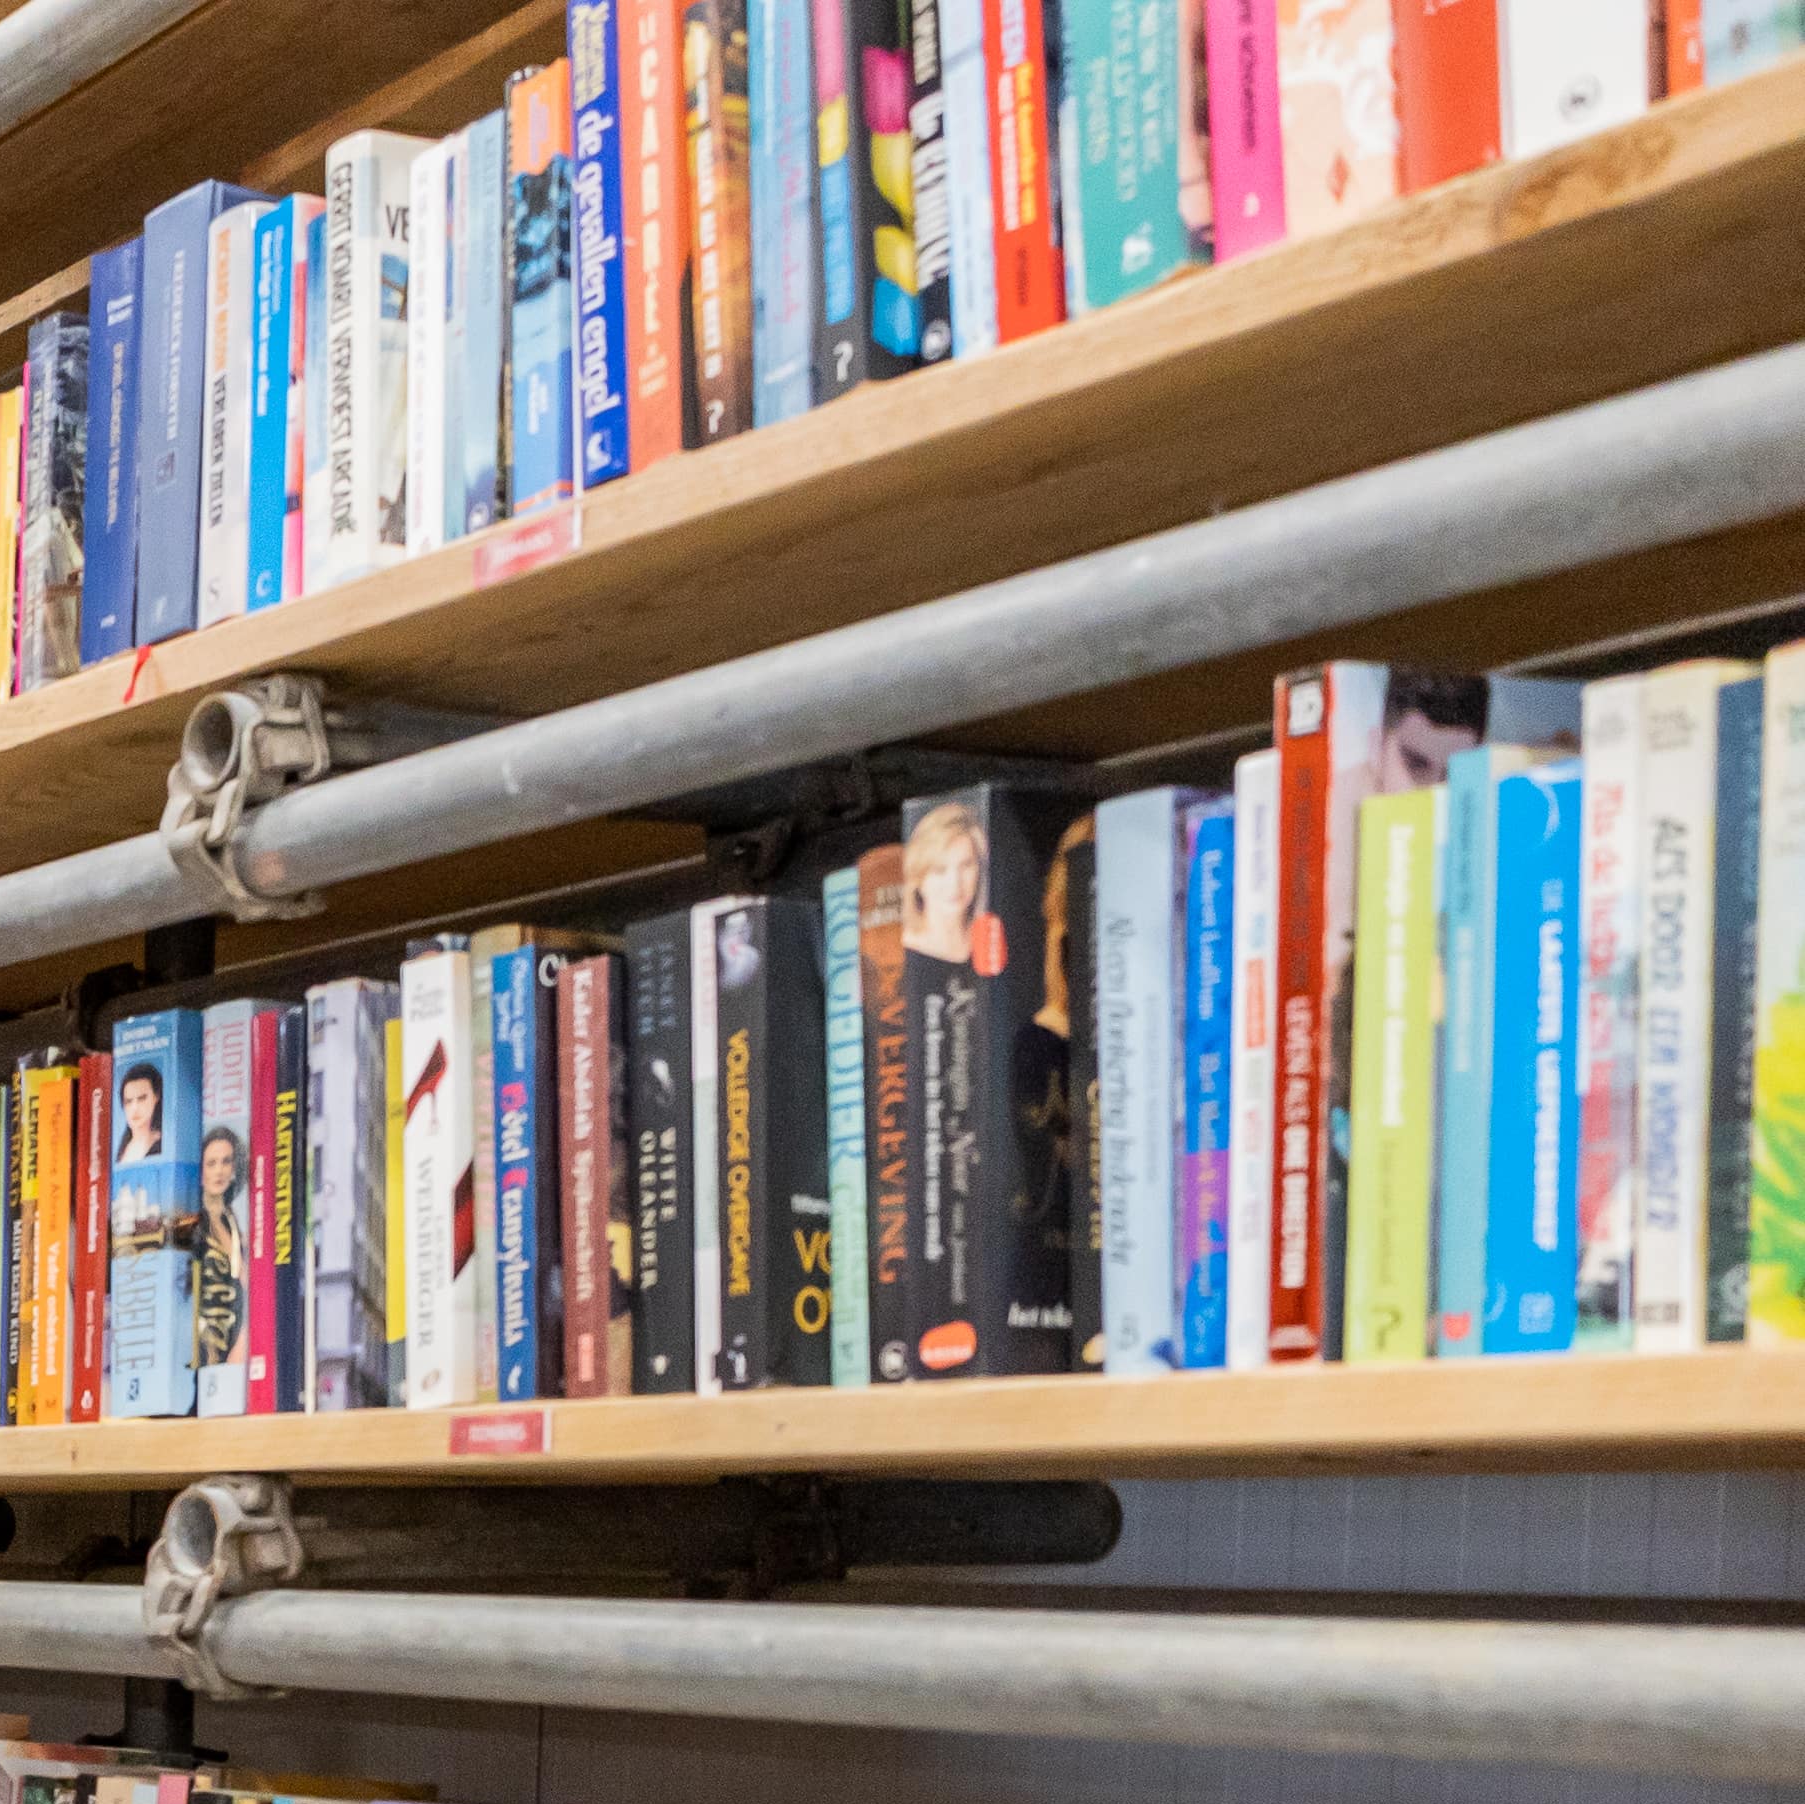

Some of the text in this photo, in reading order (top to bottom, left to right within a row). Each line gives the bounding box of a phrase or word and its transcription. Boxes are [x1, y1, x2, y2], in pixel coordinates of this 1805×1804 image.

[330, 161, 354, 237] GERRIT
[570, 111, 621, 418] de gevallen engel
[328, 332, 354, 443] VERWOEST
[329, 447, 359, 539] ARCADIË
[219, 1021, 246, 1116] JUDITH
[273, 1092, 298, 1265] HARTESTENEN
[638, 1131, 658, 1290] OLEANDER
[659, 1127, 678, 1222] WITTE
[727, 1029, 753, 1297] VOLLEDIGE OVERGAVE
[44, 1241, 62, 1375] Vader onbekend
[112, 1231, 165, 1374] ISABELLE
[414, 1156, 434, 1349] WEISBERGER
